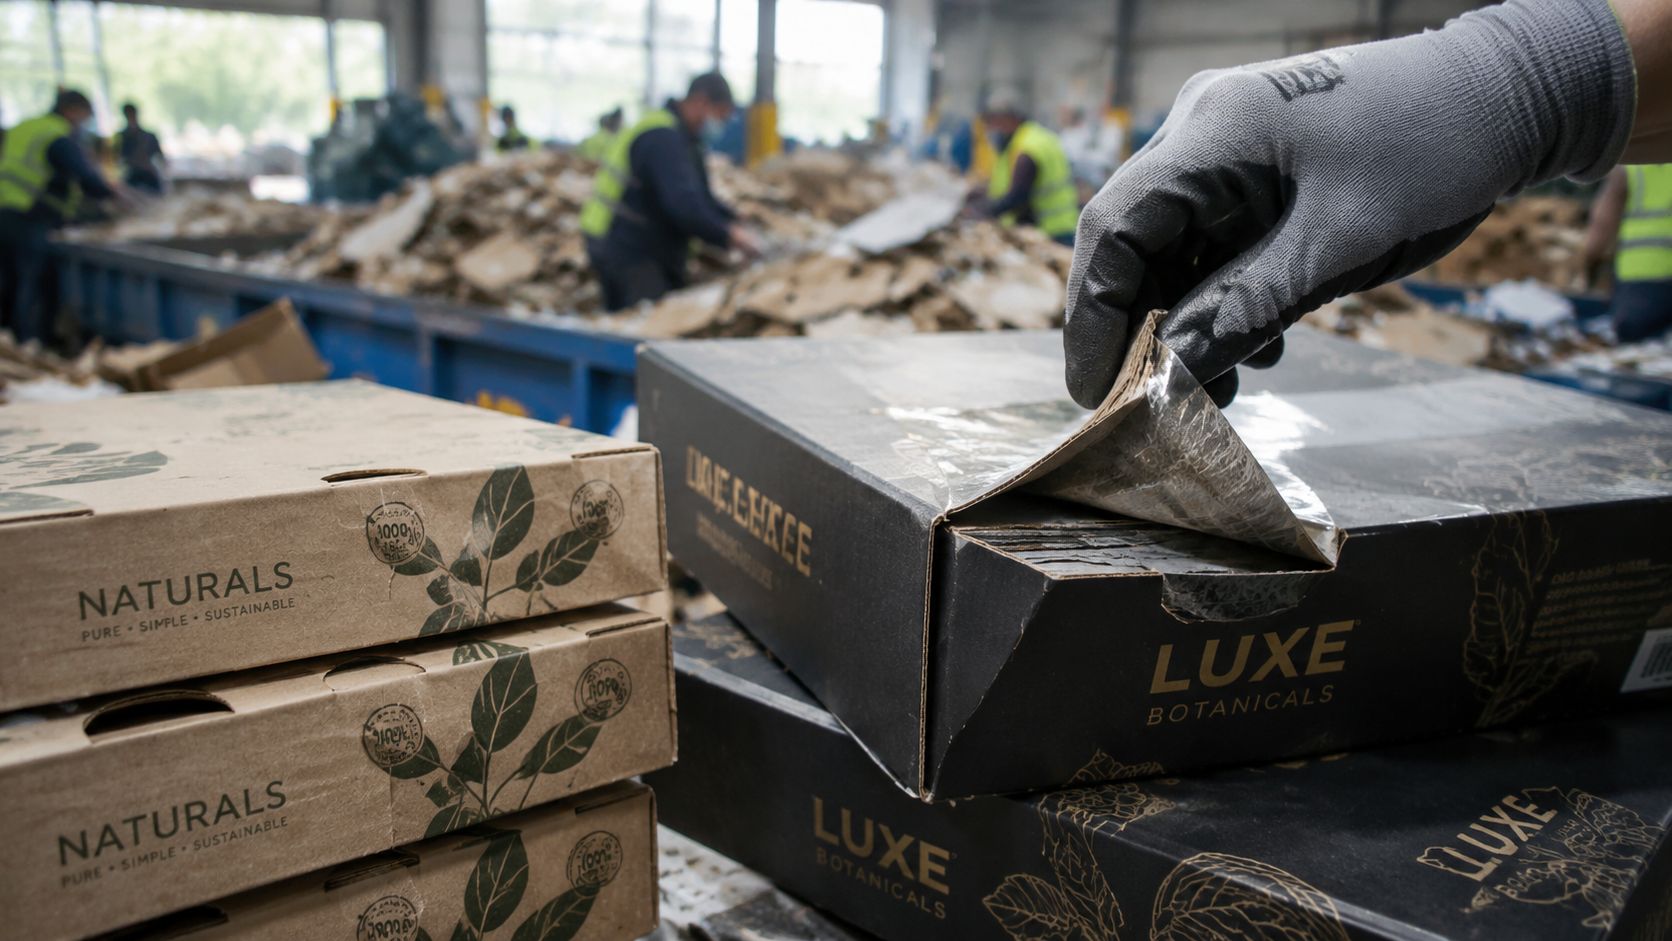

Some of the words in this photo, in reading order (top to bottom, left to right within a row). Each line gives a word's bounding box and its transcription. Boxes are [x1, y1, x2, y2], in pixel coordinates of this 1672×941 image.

[78, 561, 294, 620] NATURALS
[81, 625, 122, 642] PURE
[204, 597, 296, 622] SUSTAINABLE
[1149, 619, 1355, 694] LUXE
[1146, 684, 1335, 726] BOTANICALS
[57, 780, 287, 866] NATURALS
[61, 865, 103, 889] PURE
[121, 846, 177, 871] SIMPLE
[193, 816, 289, 851] SUSTAINABLE
[813, 796, 951, 896] LUXE
[816, 847, 947, 919] BOTANICALS
